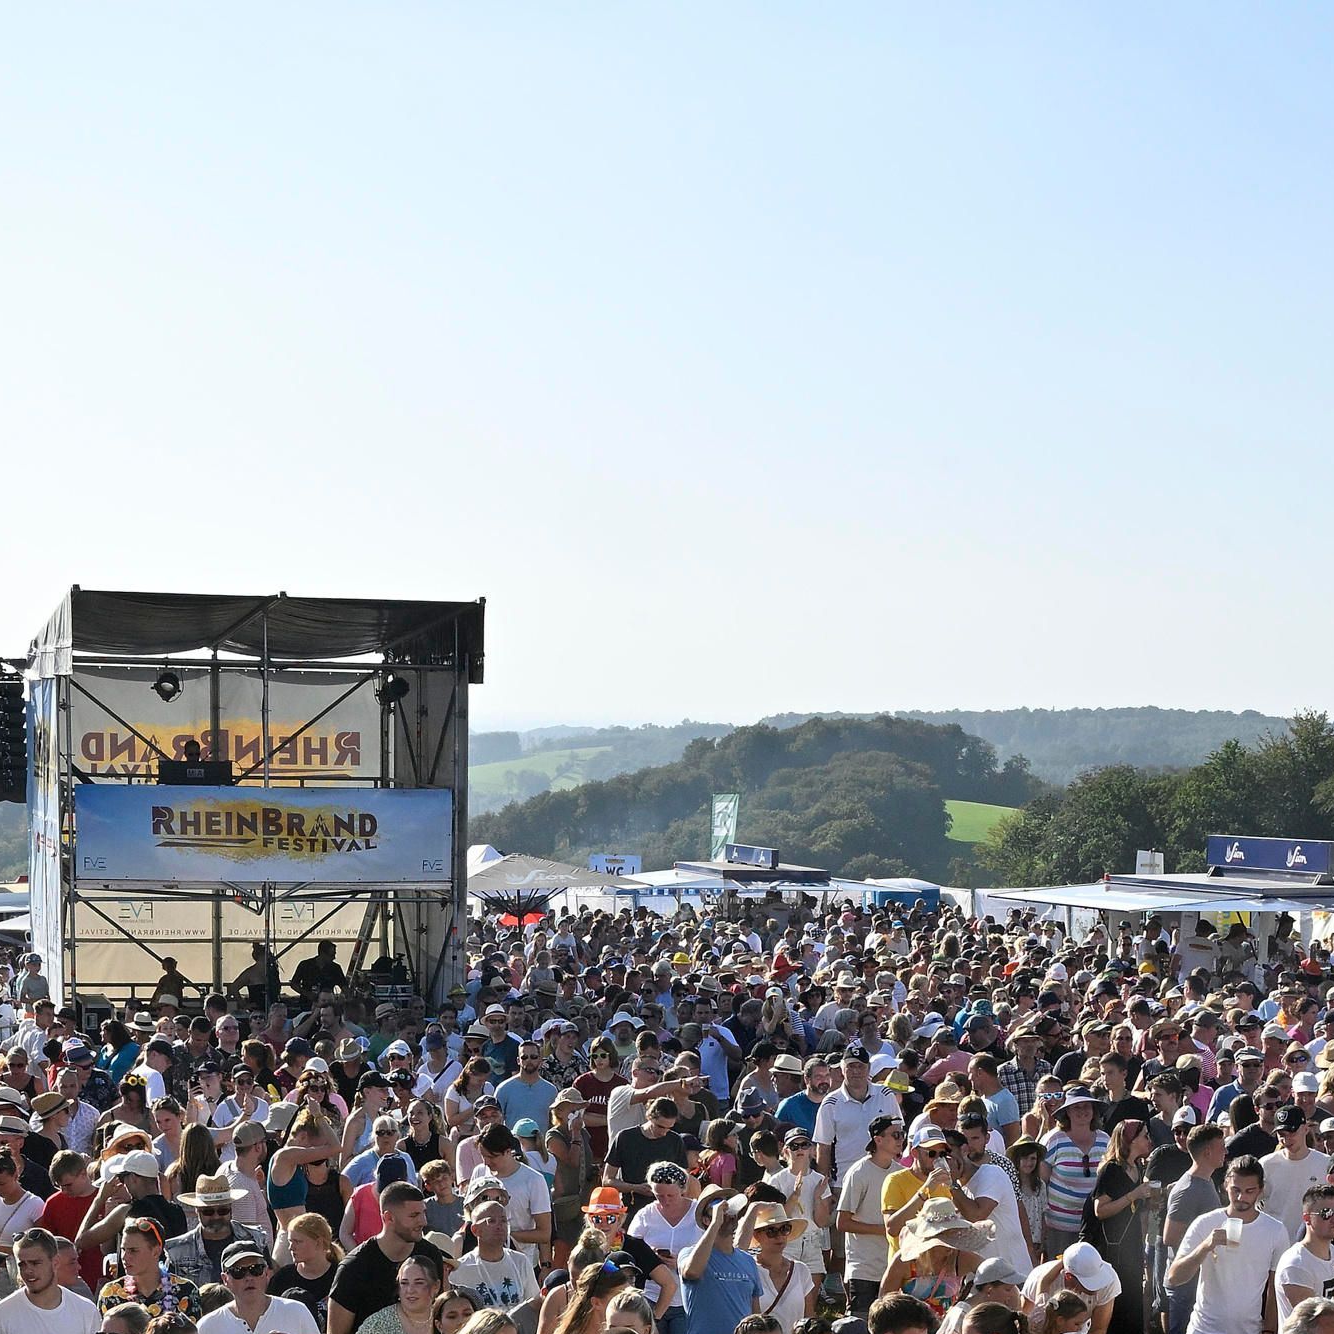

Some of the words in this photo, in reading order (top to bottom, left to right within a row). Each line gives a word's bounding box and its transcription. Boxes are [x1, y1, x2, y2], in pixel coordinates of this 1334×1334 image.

[152, 806, 378, 838] RHEINBRAND
[262, 837, 377, 853] FESTIVAL
[606, 866, 624, 876] WC
